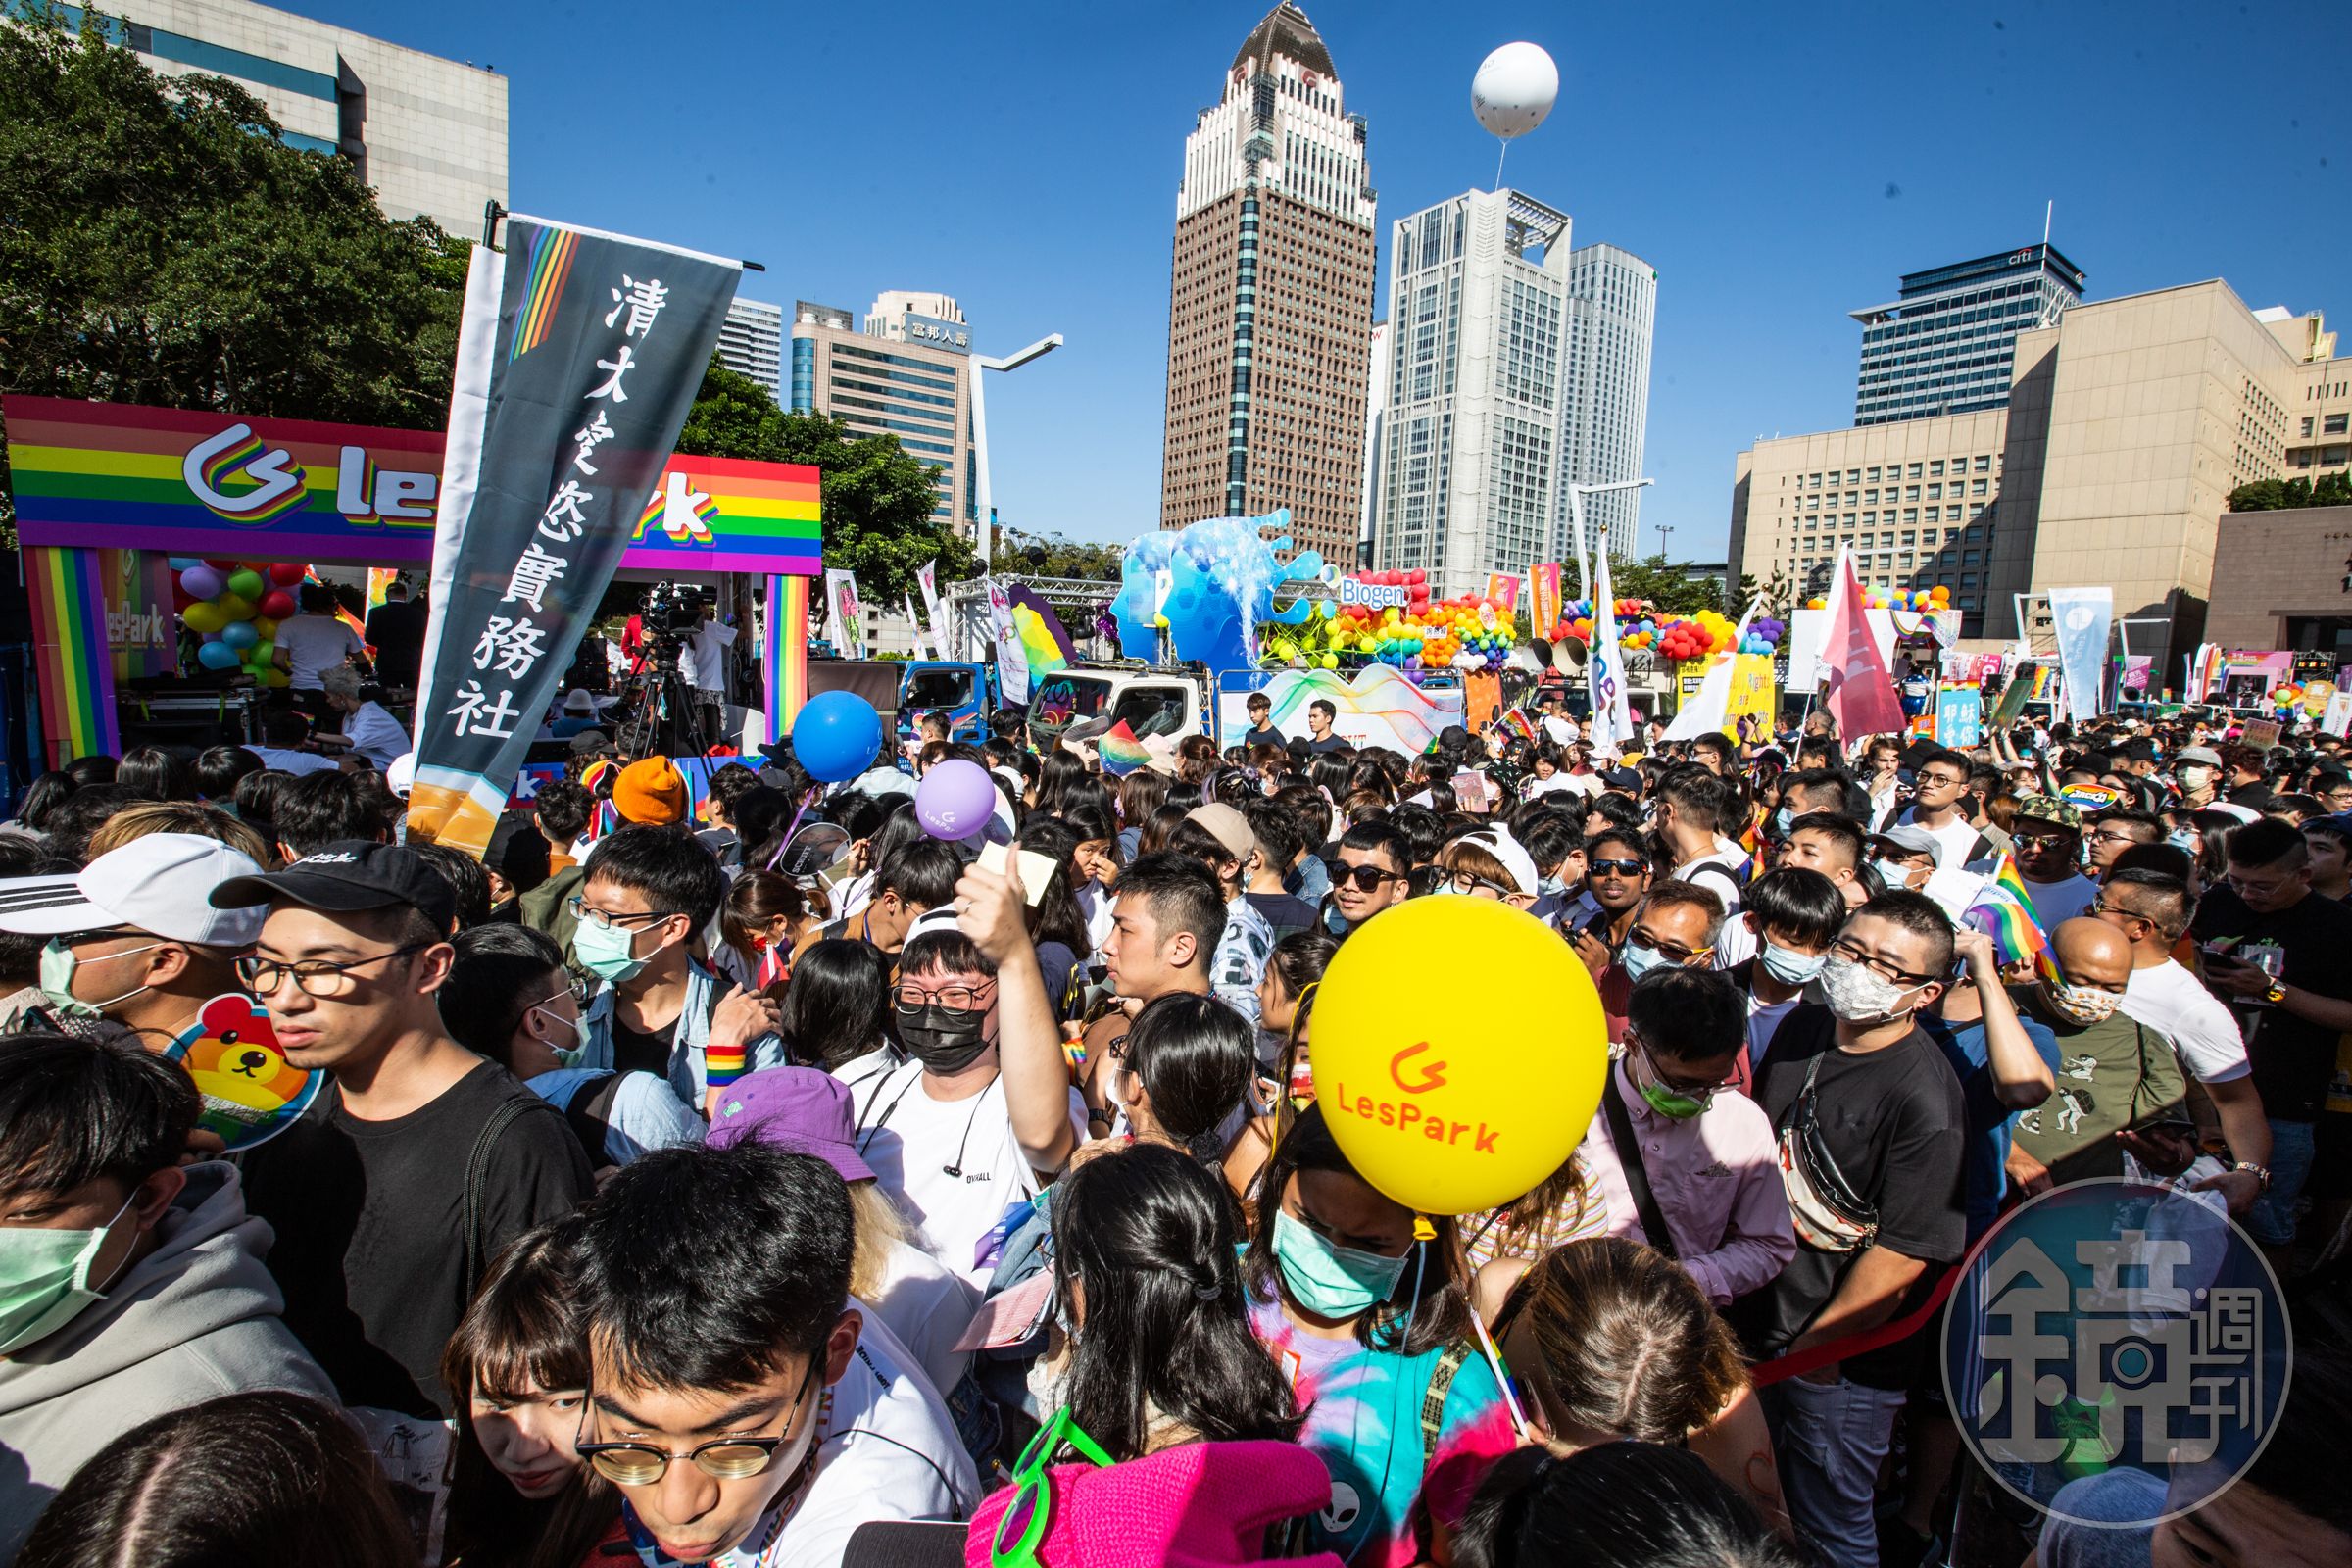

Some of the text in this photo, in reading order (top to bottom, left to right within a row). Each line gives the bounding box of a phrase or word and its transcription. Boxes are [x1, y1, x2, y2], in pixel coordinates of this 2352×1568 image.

[2008, 248, 2032, 265] citi
[912, 322, 967, 347] 富邦人壽
[1343, 578, 1406, 610] Biogen
[924, 810, 958, 834] LesPar
[1338, 1082, 1500, 1154] LesPark
